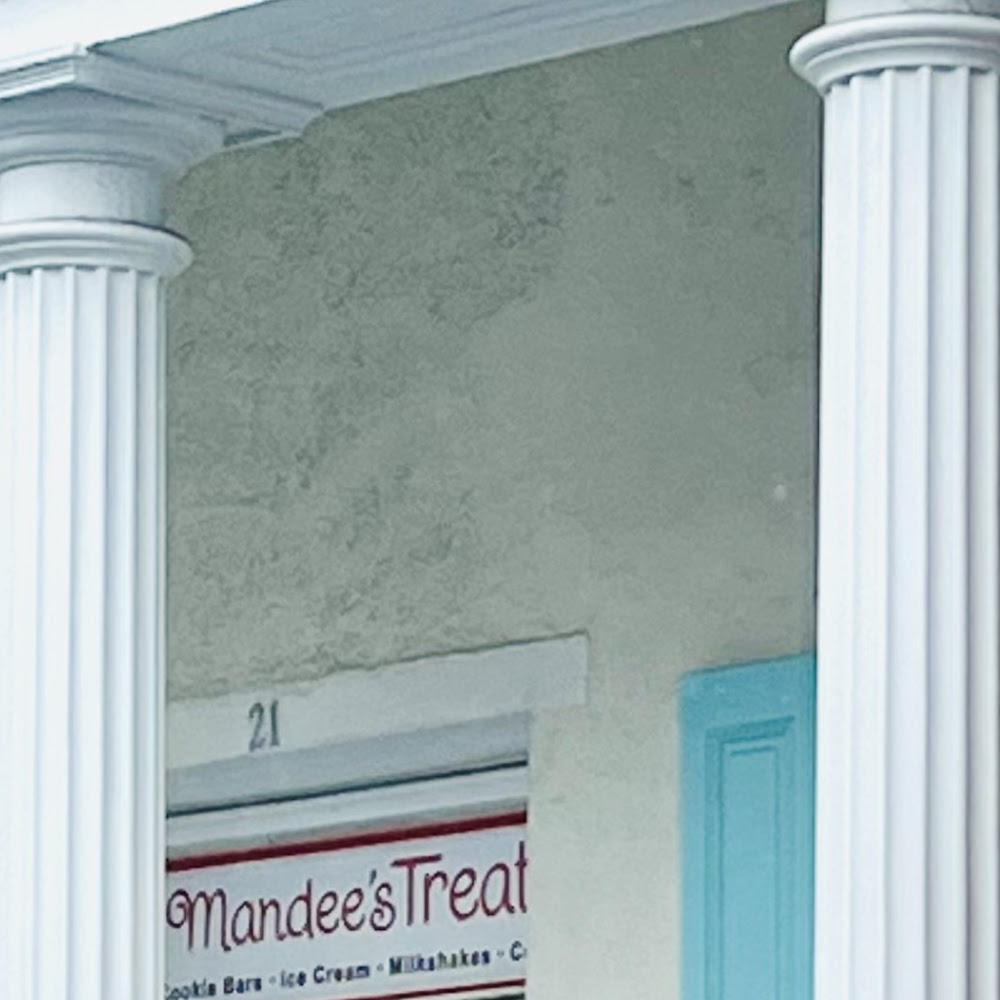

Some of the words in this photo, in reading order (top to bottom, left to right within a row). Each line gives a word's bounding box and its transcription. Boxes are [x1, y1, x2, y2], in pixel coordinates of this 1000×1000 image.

[248, 699, 280, 752] 21
[166, 868, 396, 951] Mandee's
[223, 976, 262, 994] Bars
[313, 965, 370, 987] Cream
[389, 948, 490, 976] Milkshakes
